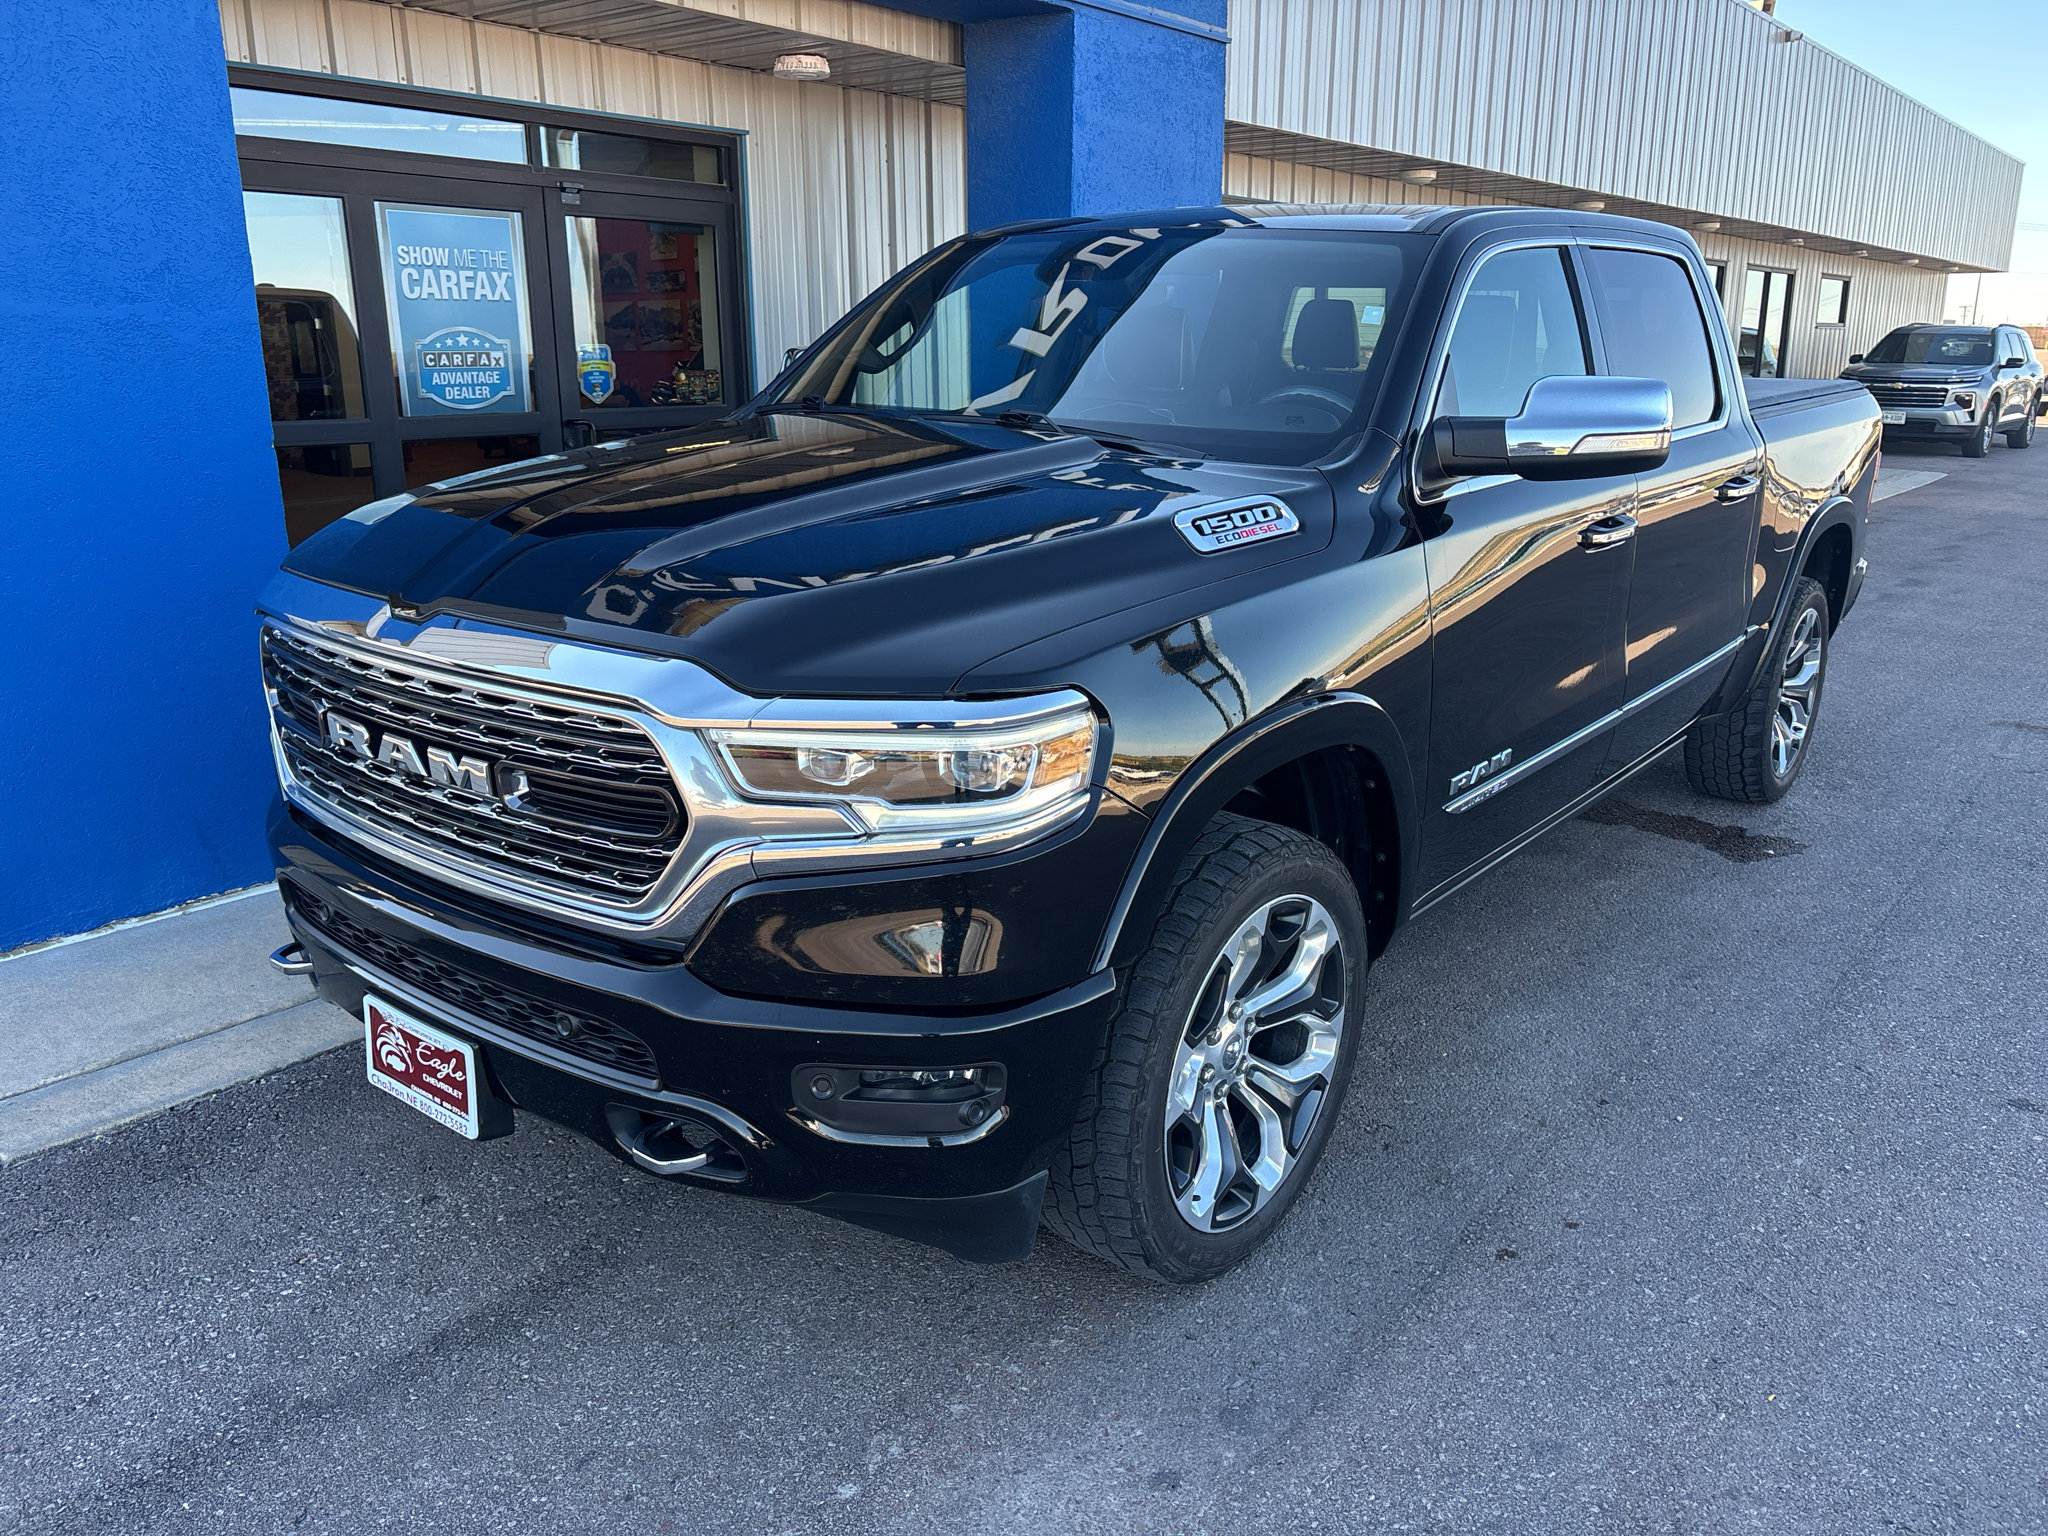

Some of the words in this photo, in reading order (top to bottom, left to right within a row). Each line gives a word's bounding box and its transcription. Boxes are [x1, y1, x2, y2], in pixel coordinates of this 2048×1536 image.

[397, 245, 449, 267] SHOW
[453, 248, 478, 268] ME
[479, 249, 509, 270] THE
[401, 267, 511, 301] CARFAX
[425, 353, 502, 367] CARFAX
[432, 371, 501, 385] ADVANTAGE
[445, 386, 491, 400] DEALER
[1195, 506, 1277, 534] 1500
[1215, 523, 1284, 545] ECODIESEL
[327, 711, 495, 796] RAM
[1449, 748, 1512, 796] RAM
[415, 1041, 466, 1081] Eagle
[422, 1073, 463, 1100] CHEVROLET
